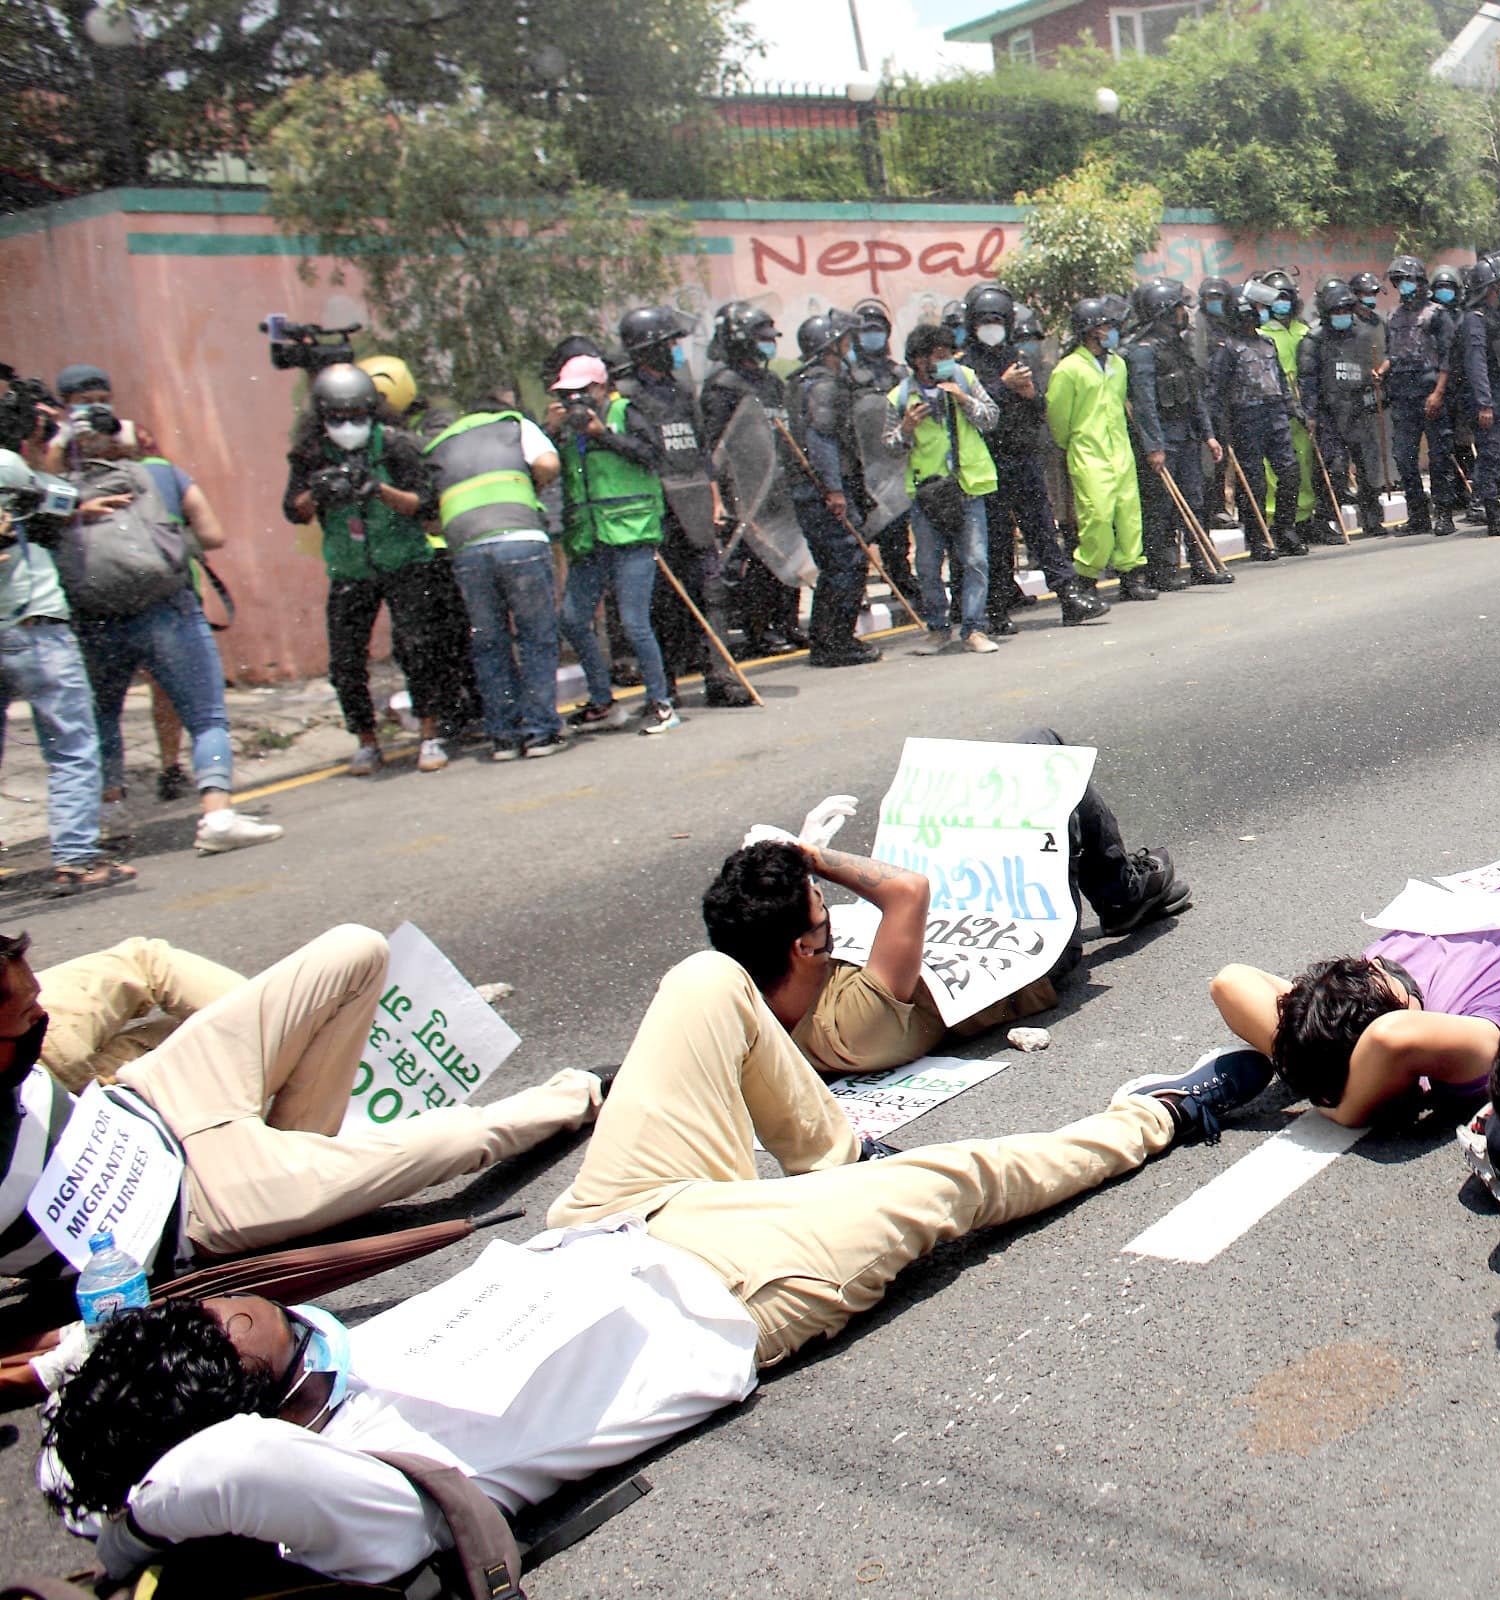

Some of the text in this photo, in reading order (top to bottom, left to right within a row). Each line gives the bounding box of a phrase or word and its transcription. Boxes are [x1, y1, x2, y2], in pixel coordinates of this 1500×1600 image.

[750, 227, 1005, 295] Nepal
[46, 1110, 111, 1223] DIGNITY FOR
[66, 1140, 125, 1239] MIGRANTS
[94, 1146, 149, 1236] ETURNEES
